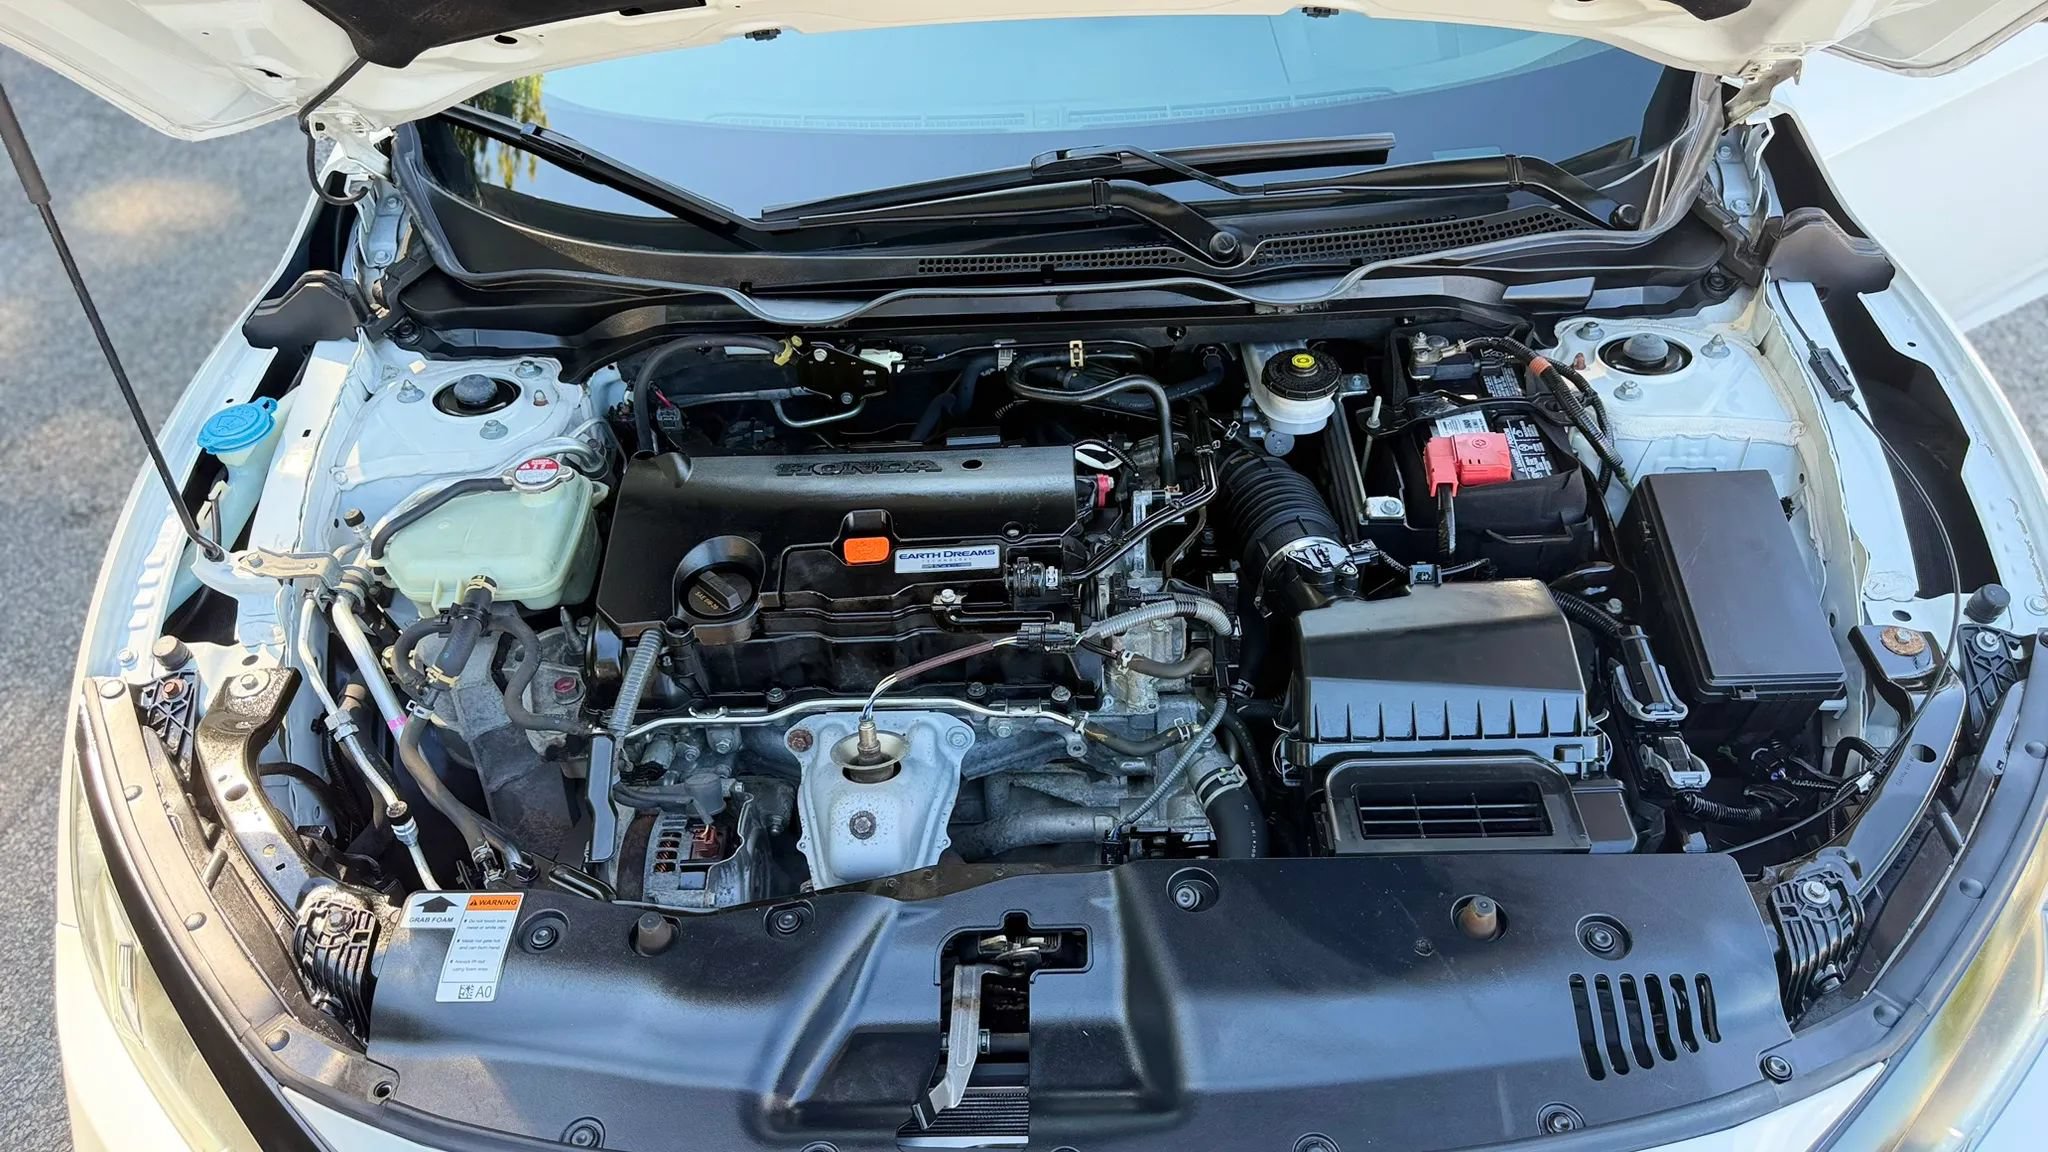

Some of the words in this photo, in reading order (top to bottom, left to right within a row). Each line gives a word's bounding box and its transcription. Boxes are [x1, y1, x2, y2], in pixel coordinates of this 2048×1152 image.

[775, 460, 943, 477] HONDA
[899, 552, 940, 560] EARTH
[943, 549, 996, 558] DREAMS
[475, 985, 493, 998] A0
